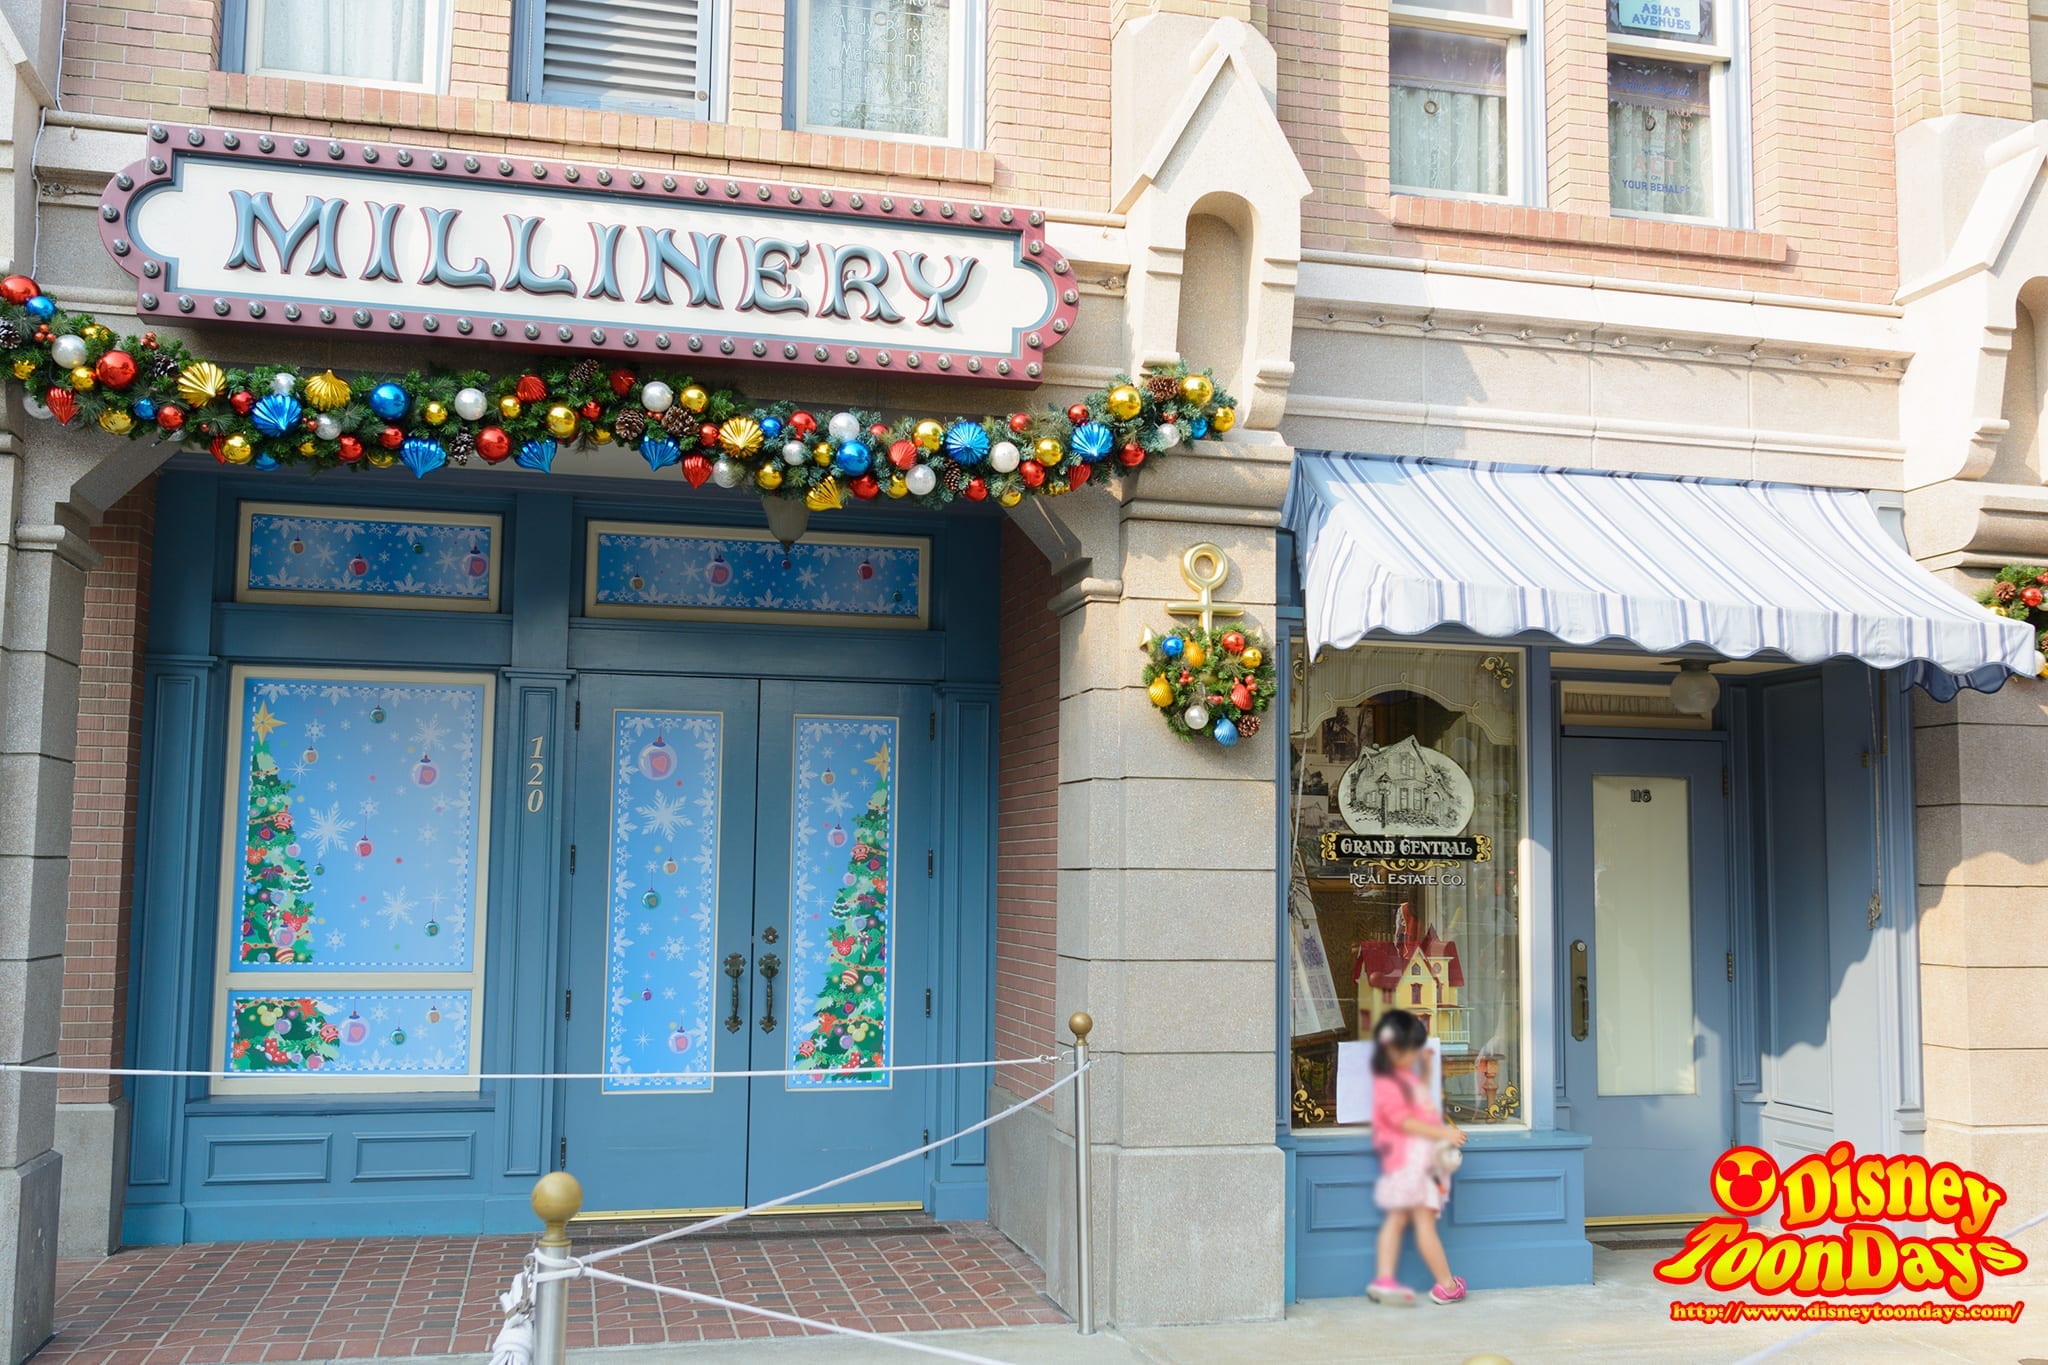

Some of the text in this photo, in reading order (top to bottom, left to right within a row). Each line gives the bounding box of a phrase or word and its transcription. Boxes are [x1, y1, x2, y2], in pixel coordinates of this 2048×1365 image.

[1641, 3, 1681, 17] ASIA'S
[1631, 13, 1692, 31] AVENUES
[1631, 155, 1681, 175] ACT
[1622, 179, 1648, 191] YOUR
[225, 189, 978, 329] MILLINERY
[527, 735, 544, 813] 120
[1340, 838, 1473, 857] GRAND CENTRAL
[1350, 873, 1465, 887] REAL ESTATE CO.
